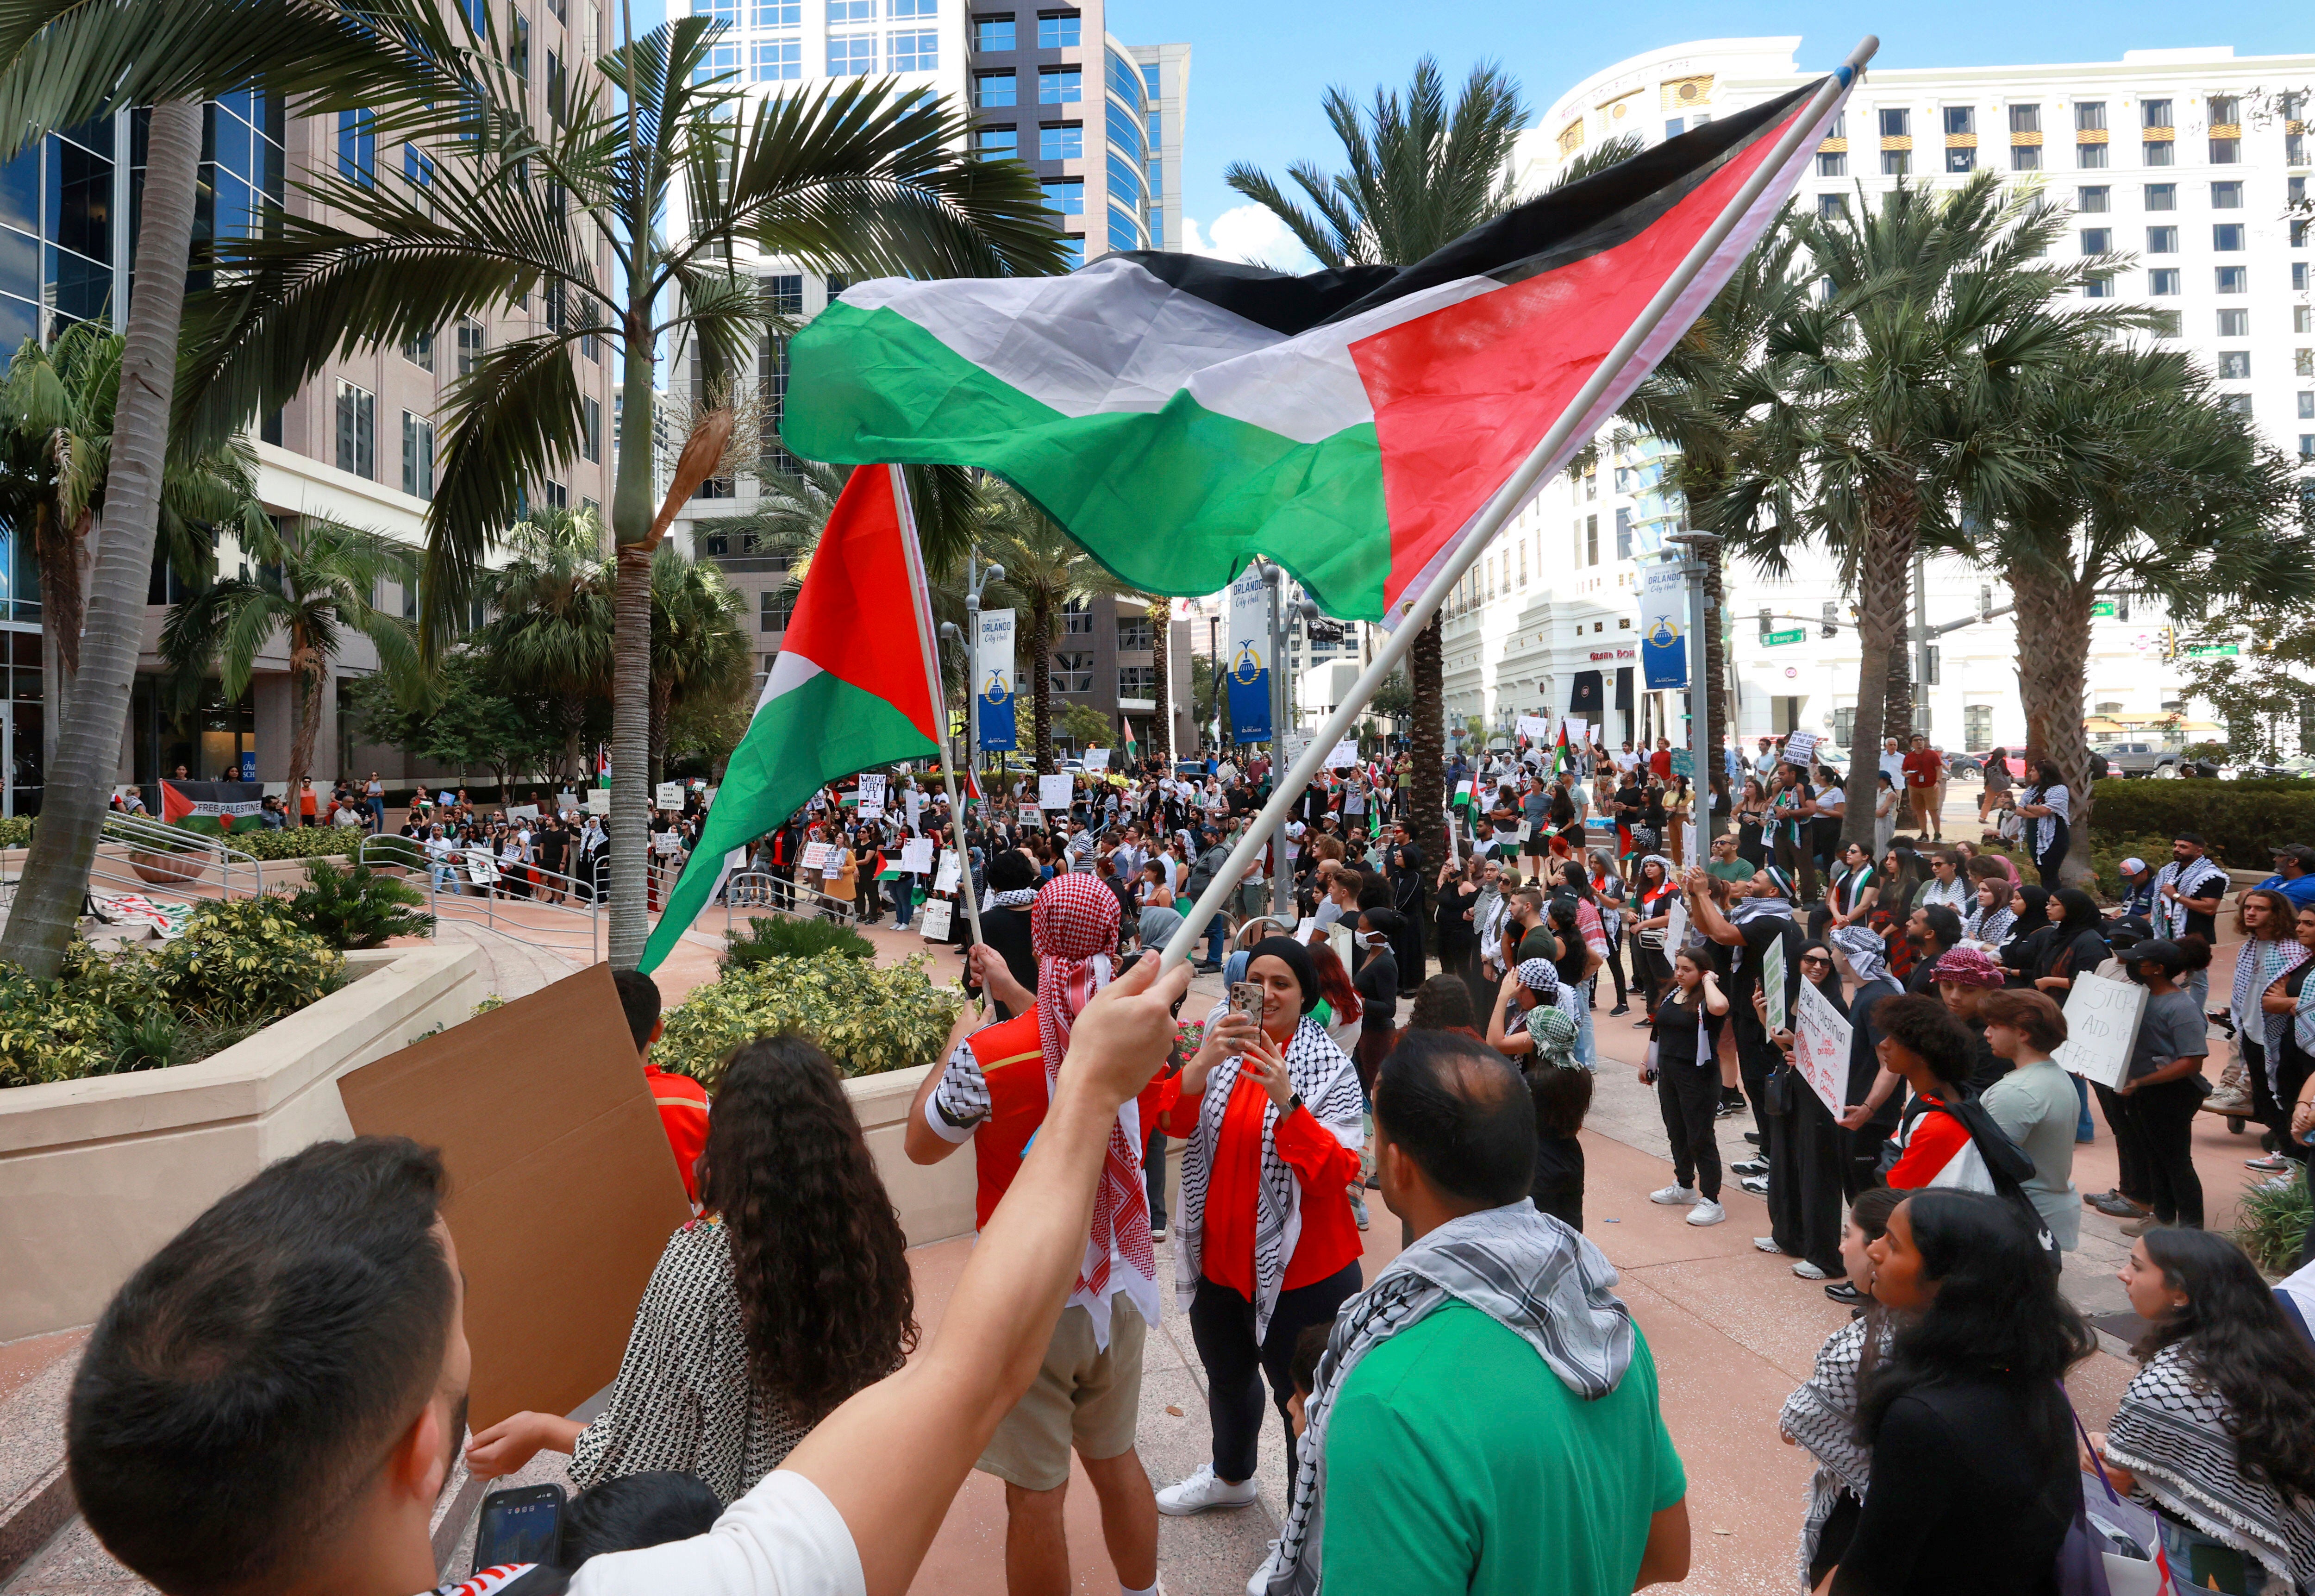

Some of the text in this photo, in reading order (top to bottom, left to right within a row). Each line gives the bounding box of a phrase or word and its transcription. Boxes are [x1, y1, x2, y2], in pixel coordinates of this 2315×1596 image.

[1648, 572, 1681, 584] ORLANDO
[1233, 579, 1263, 595] ORLANDO
[1651, 581, 1678, 593] City Hall
[1236, 591, 1260, 609] City Hall
[982, 621, 1011, 632] ORLANDO
[985, 631, 1008, 644] City Hall
[1773, 634, 1793, 642] Orange
[1589, 649, 1635, 661] GRAND BOH
[1785, 749, 1809, 760] PALESTINE
[243, 761, 255, 770] cha
[861, 783, 884, 791] SLEEPY
[198, 804, 219, 813] FREE
[506, 844, 521, 852] VICTORY
[2084, 983, 2133, 1014] STOP
[2081, 1014, 2109, 1037] AID
[2061, 1039, 2101, 1072] FREE
